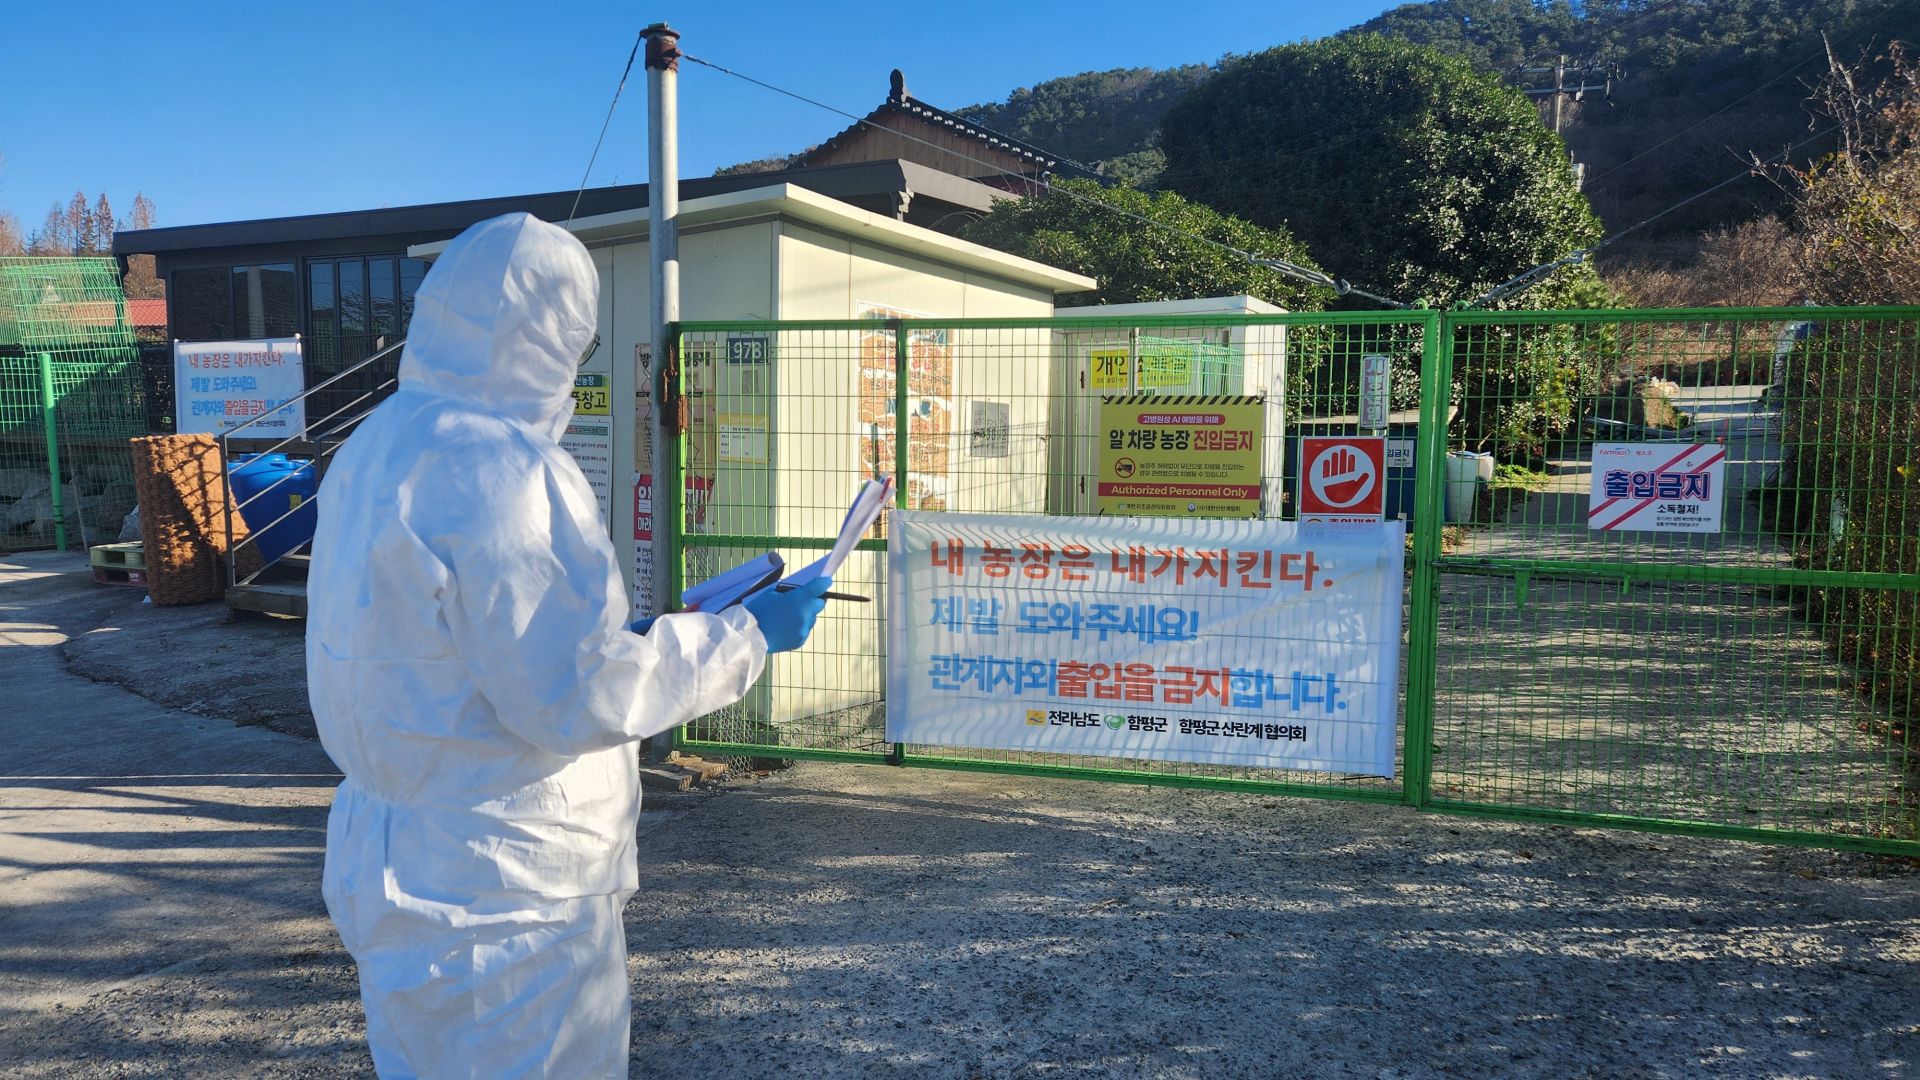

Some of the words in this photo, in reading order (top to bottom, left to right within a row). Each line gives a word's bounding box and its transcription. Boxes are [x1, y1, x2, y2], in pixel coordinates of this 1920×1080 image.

[189, 353, 198, 368] 내
[203, 353, 230, 368] 농장은
[191, 377, 210, 392] 제발
[1172, 416, 1180, 424] AI
[1204, 415, 1219, 424] 위해
[1110, 430, 1124, 449] 알
[1128, 429, 1157, 450] 차량
[1161, 429, 1190, 450] 농장
[1194, 430, 1253, 451] 진입금지
[1111, 485, 1167, 495] Authorized
[1169, 487, 1221, 497] Personnel
[1223, 488, 1248, 498] Only
[1604, 470, 1710, 500] 출입금지
[1657, 504, 1699, 515] 소독철저!
[931, 538, 963, 576] 내
[980, 540, 1094, 581] 농장은
[1111, 545, 1333, 592] 내가지킨다.
[929, 596, 1003, 635] 제발
[1015, 601, 1199, 644] 도와주세요!
[1049, 711, 1101, 727] 전라남도
[1128, 715, 1168, 732] 함평군
